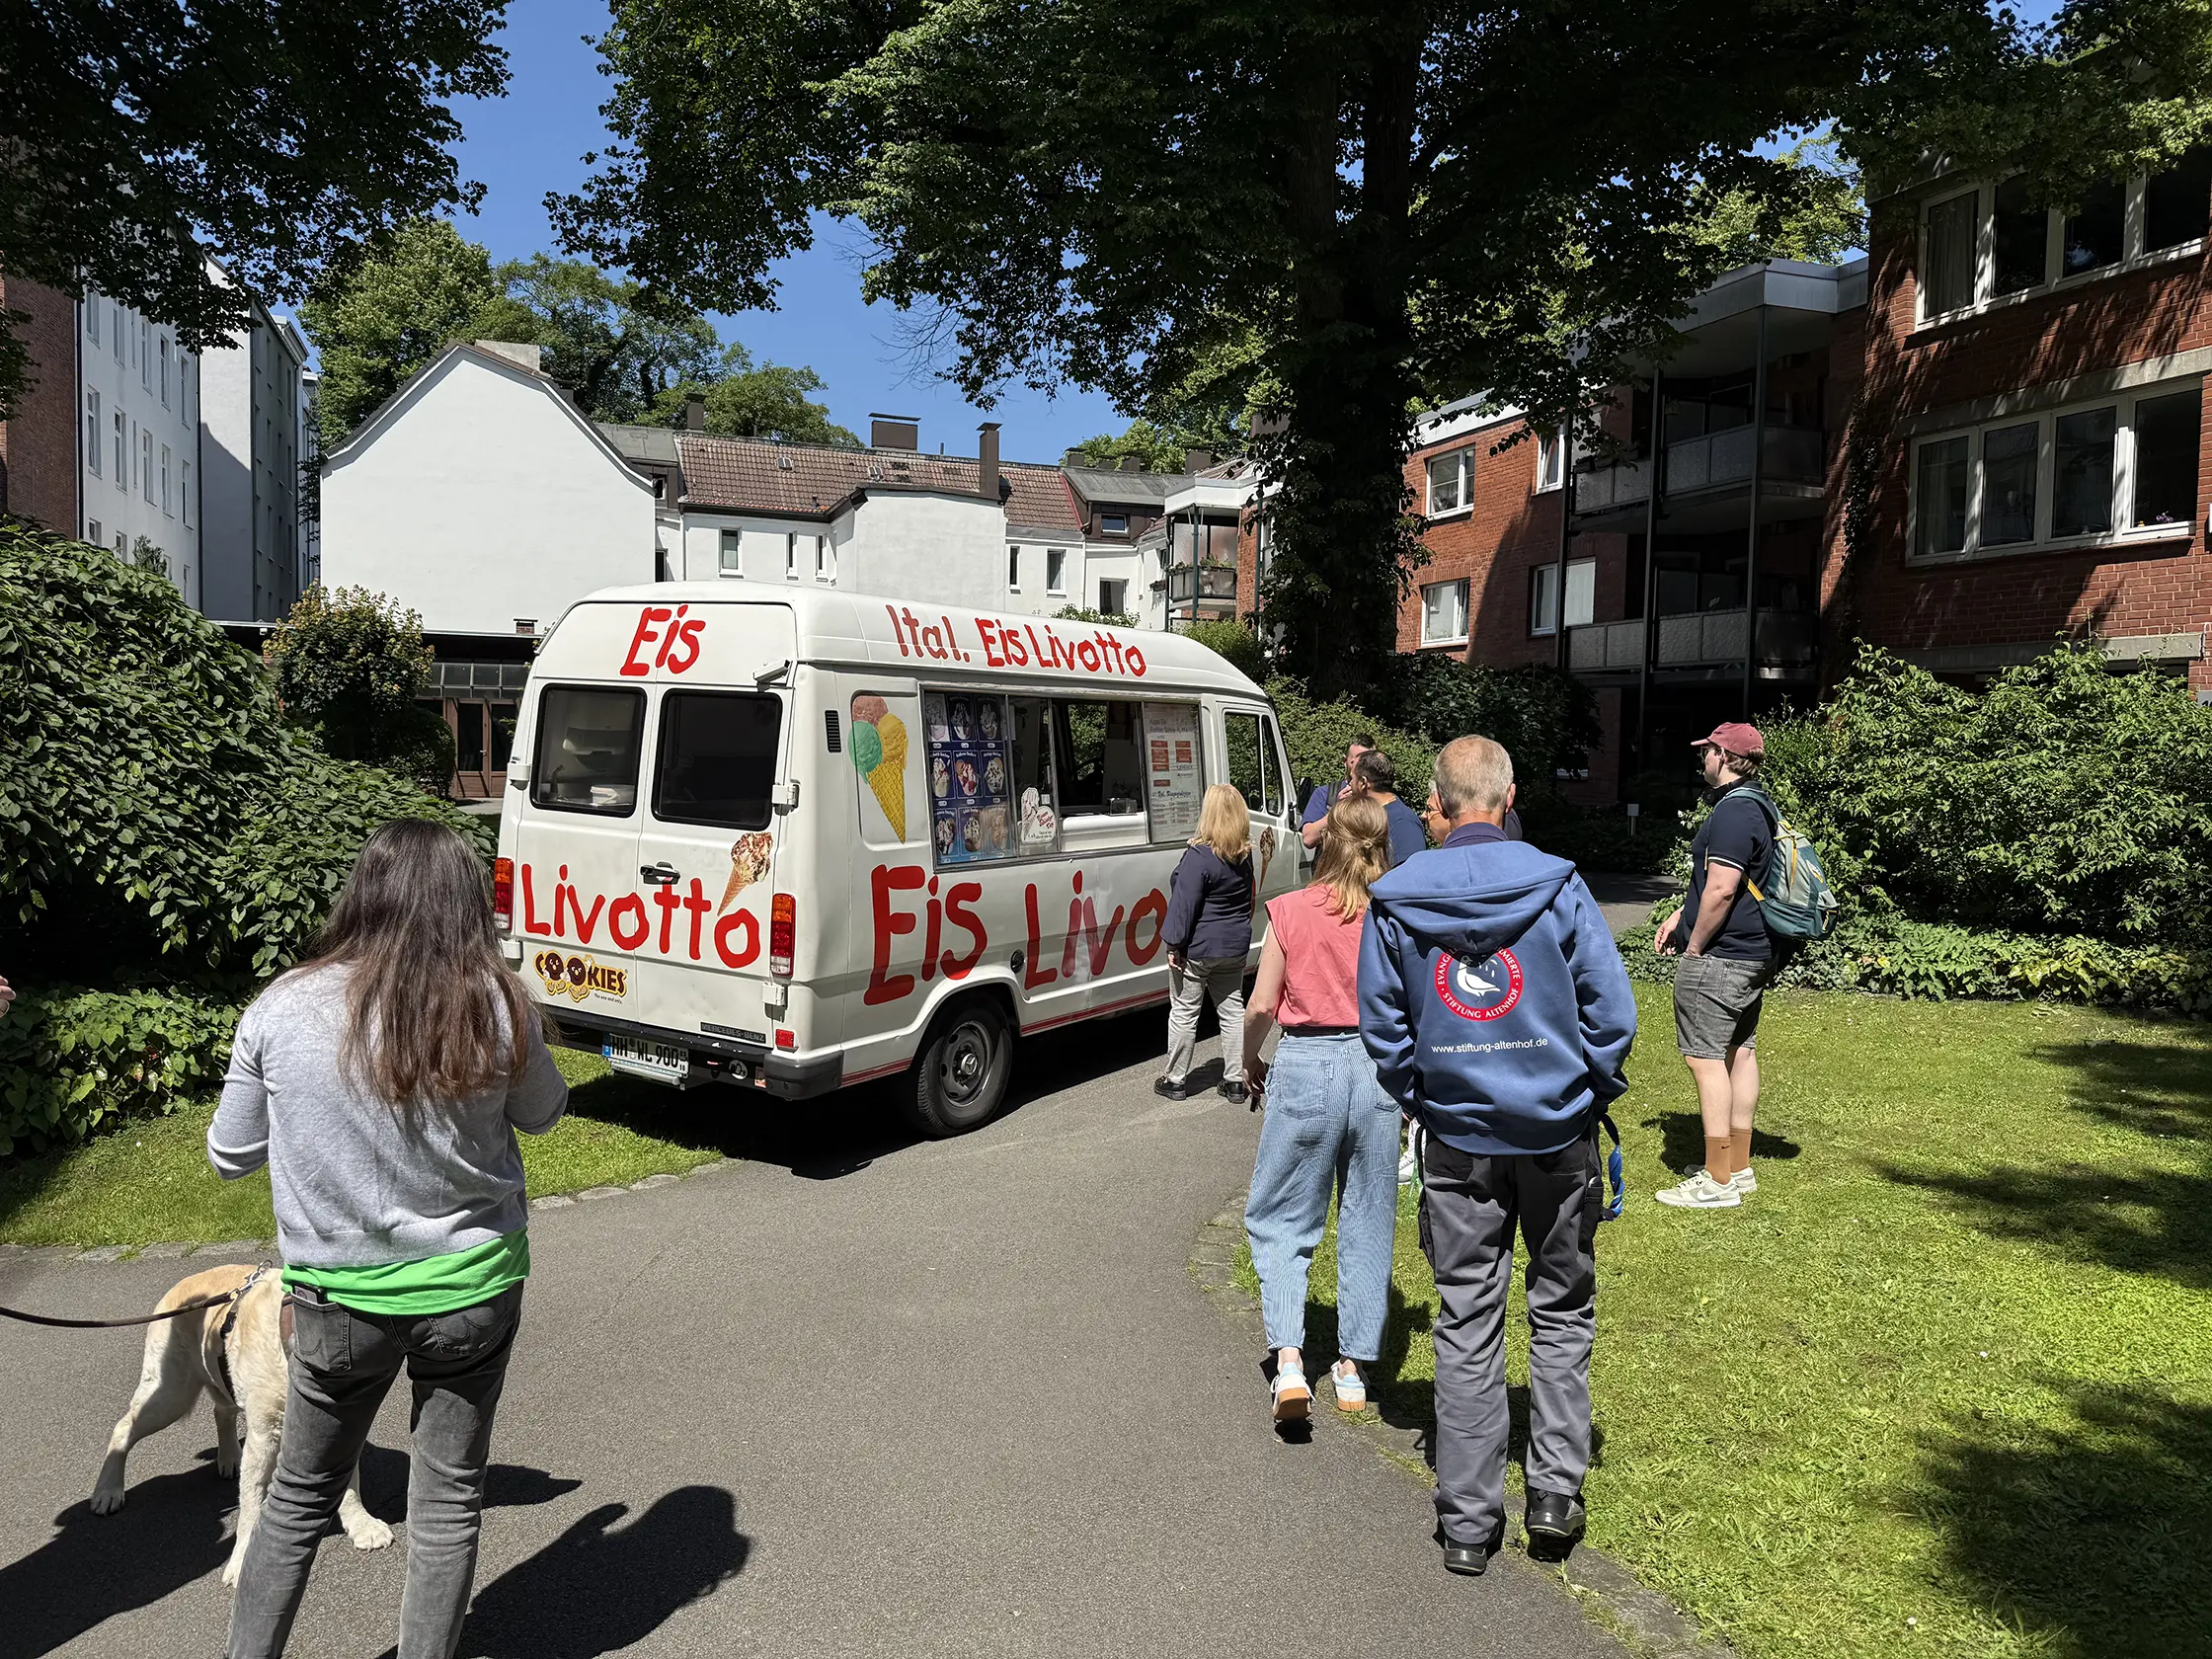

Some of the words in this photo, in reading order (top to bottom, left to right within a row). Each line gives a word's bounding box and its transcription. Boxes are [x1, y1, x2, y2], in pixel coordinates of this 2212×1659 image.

[620, 603, 706, 676] Eis
[886, 604, 970, 663] Ital.
[975, 618, 1029, 668] Eis
[1024, 624, 1146, 677] Livotto
[521, 863, 761, 969] Livotto
[863, 864, 988, 1006] Eis
[1024, 869, 1256, 990] Livo
[535, 952, 627, 993] COOKIES
[1442, 991, 1482, 1018] STIFTUNG
[1484, 988, 1520, 1018] ALTENHOF
[656, 1044, 679, 1068] 900
[1431, 1037, 1548, 1054] www.stiftung-altenhof.de
